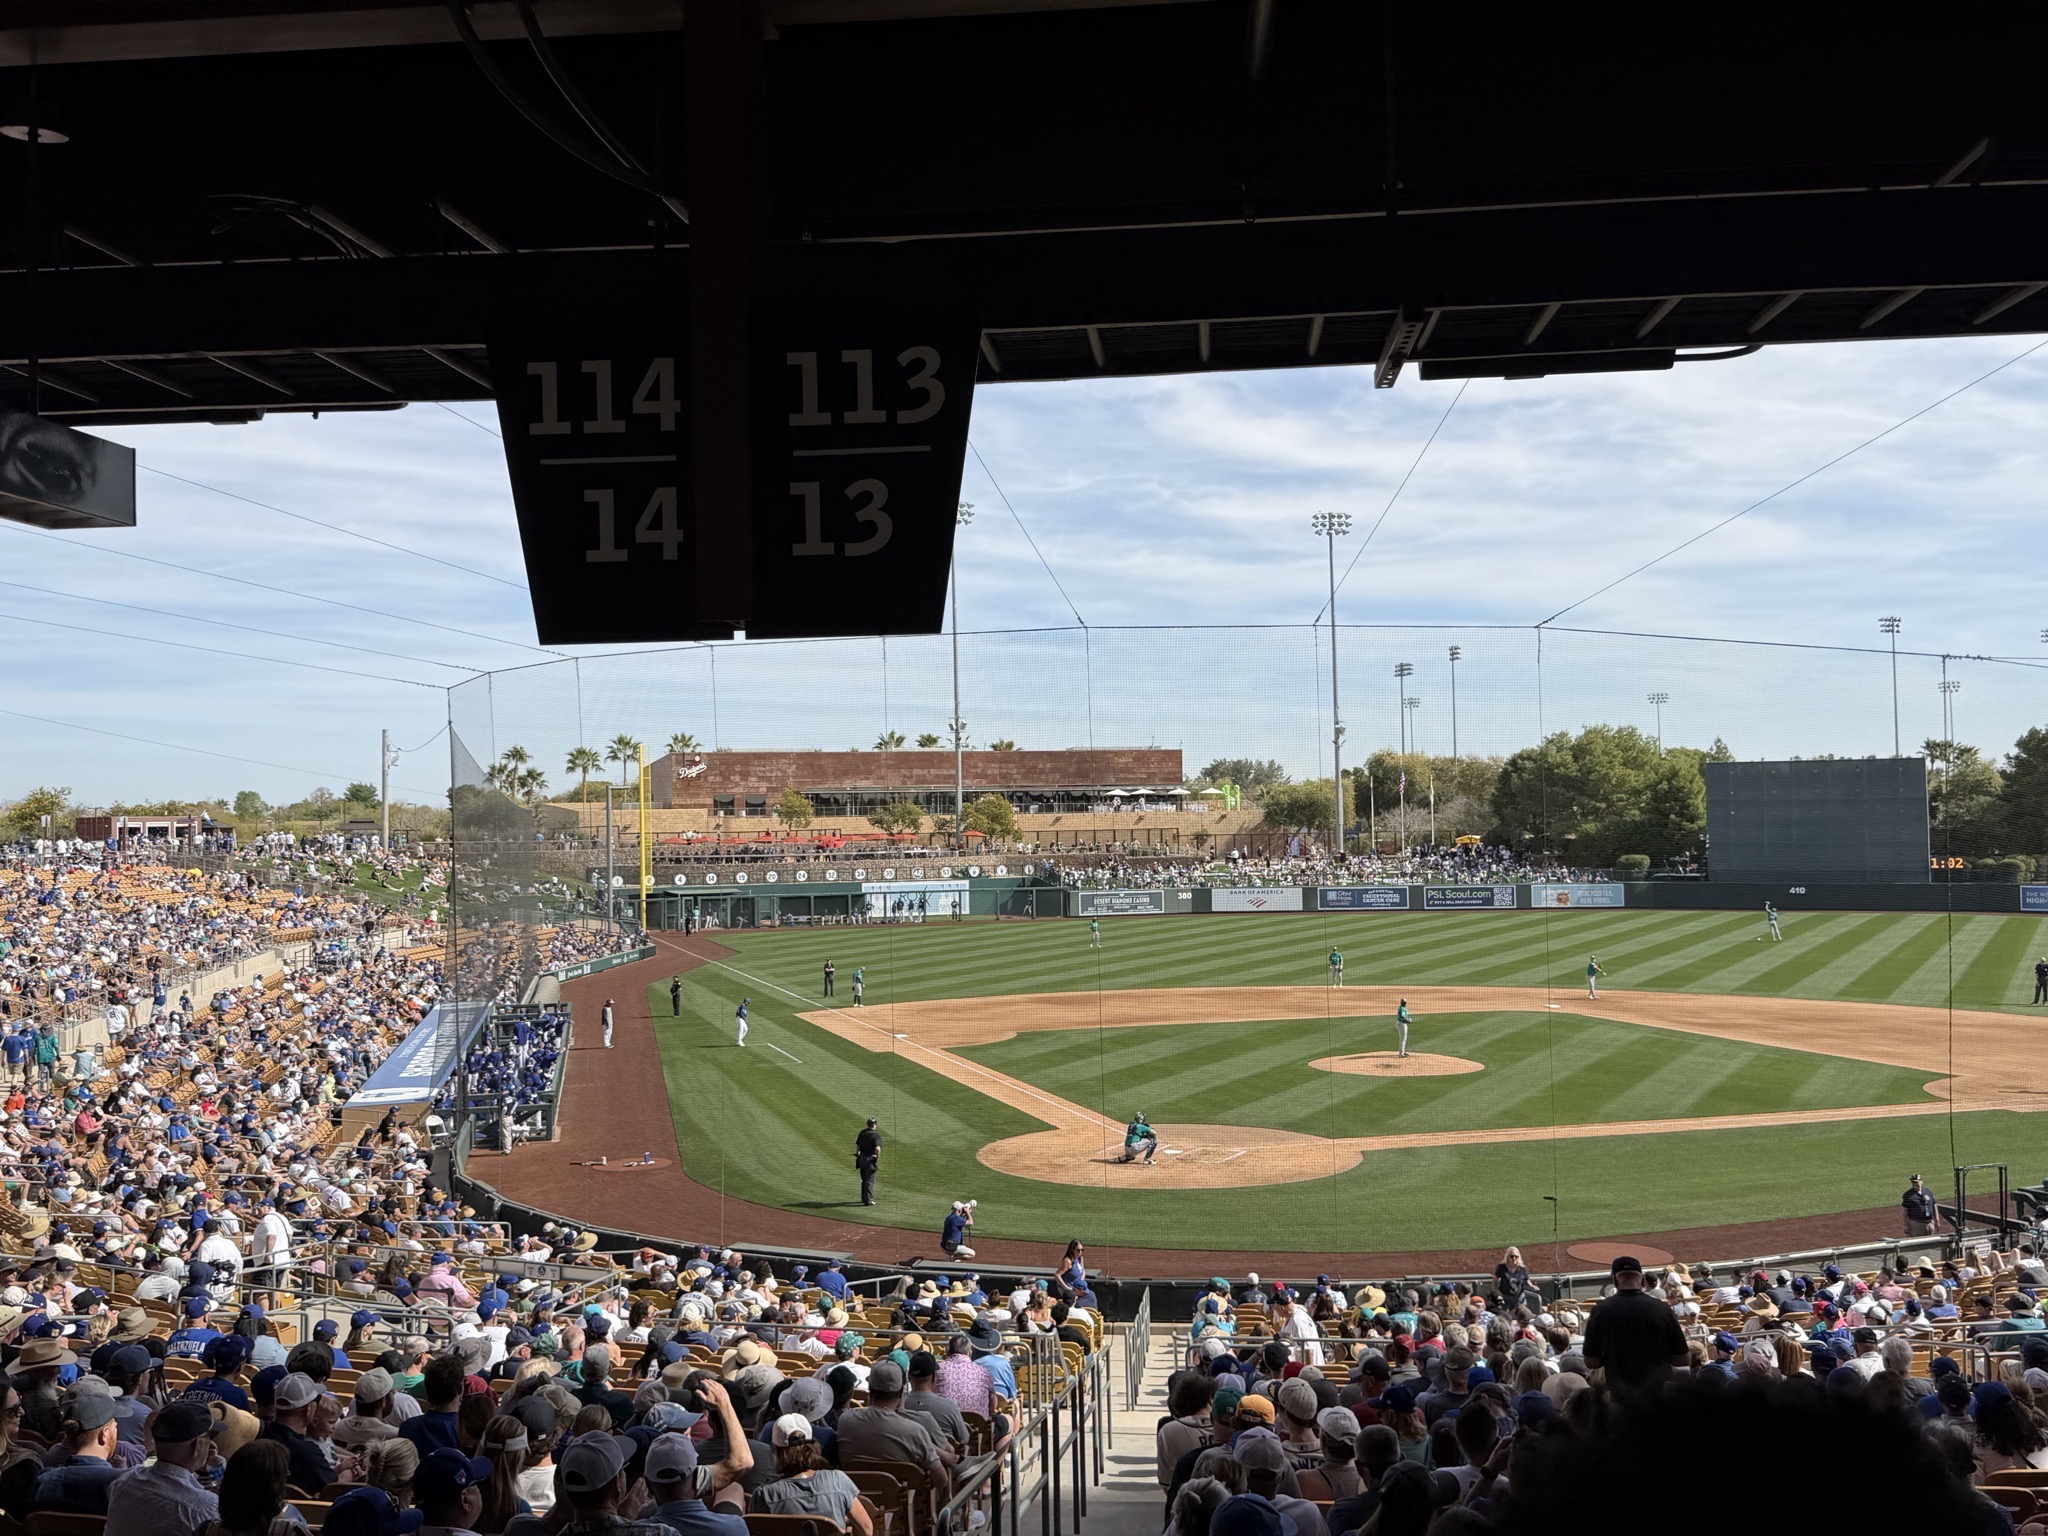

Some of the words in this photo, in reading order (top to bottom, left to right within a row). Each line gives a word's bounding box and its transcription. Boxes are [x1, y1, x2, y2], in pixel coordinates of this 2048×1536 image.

[787, 346, 946, 427] 113
[527, 358, 681, 435] 114
[790, 478, 893, 557] 13
[584, 487, 684, 563] 14
[679, 763, 707, 778] Dodgers
[1930, 857, 1964, 869] 1:02
[1177, 892, 1192, 900] 380
[1427, 890, 1444, 899] PSL
[1445, 889, 1491, 899] Scout.com
[1789, 886, 1806, 894] 410
[1093, 897, 1111, 905] DESERT
